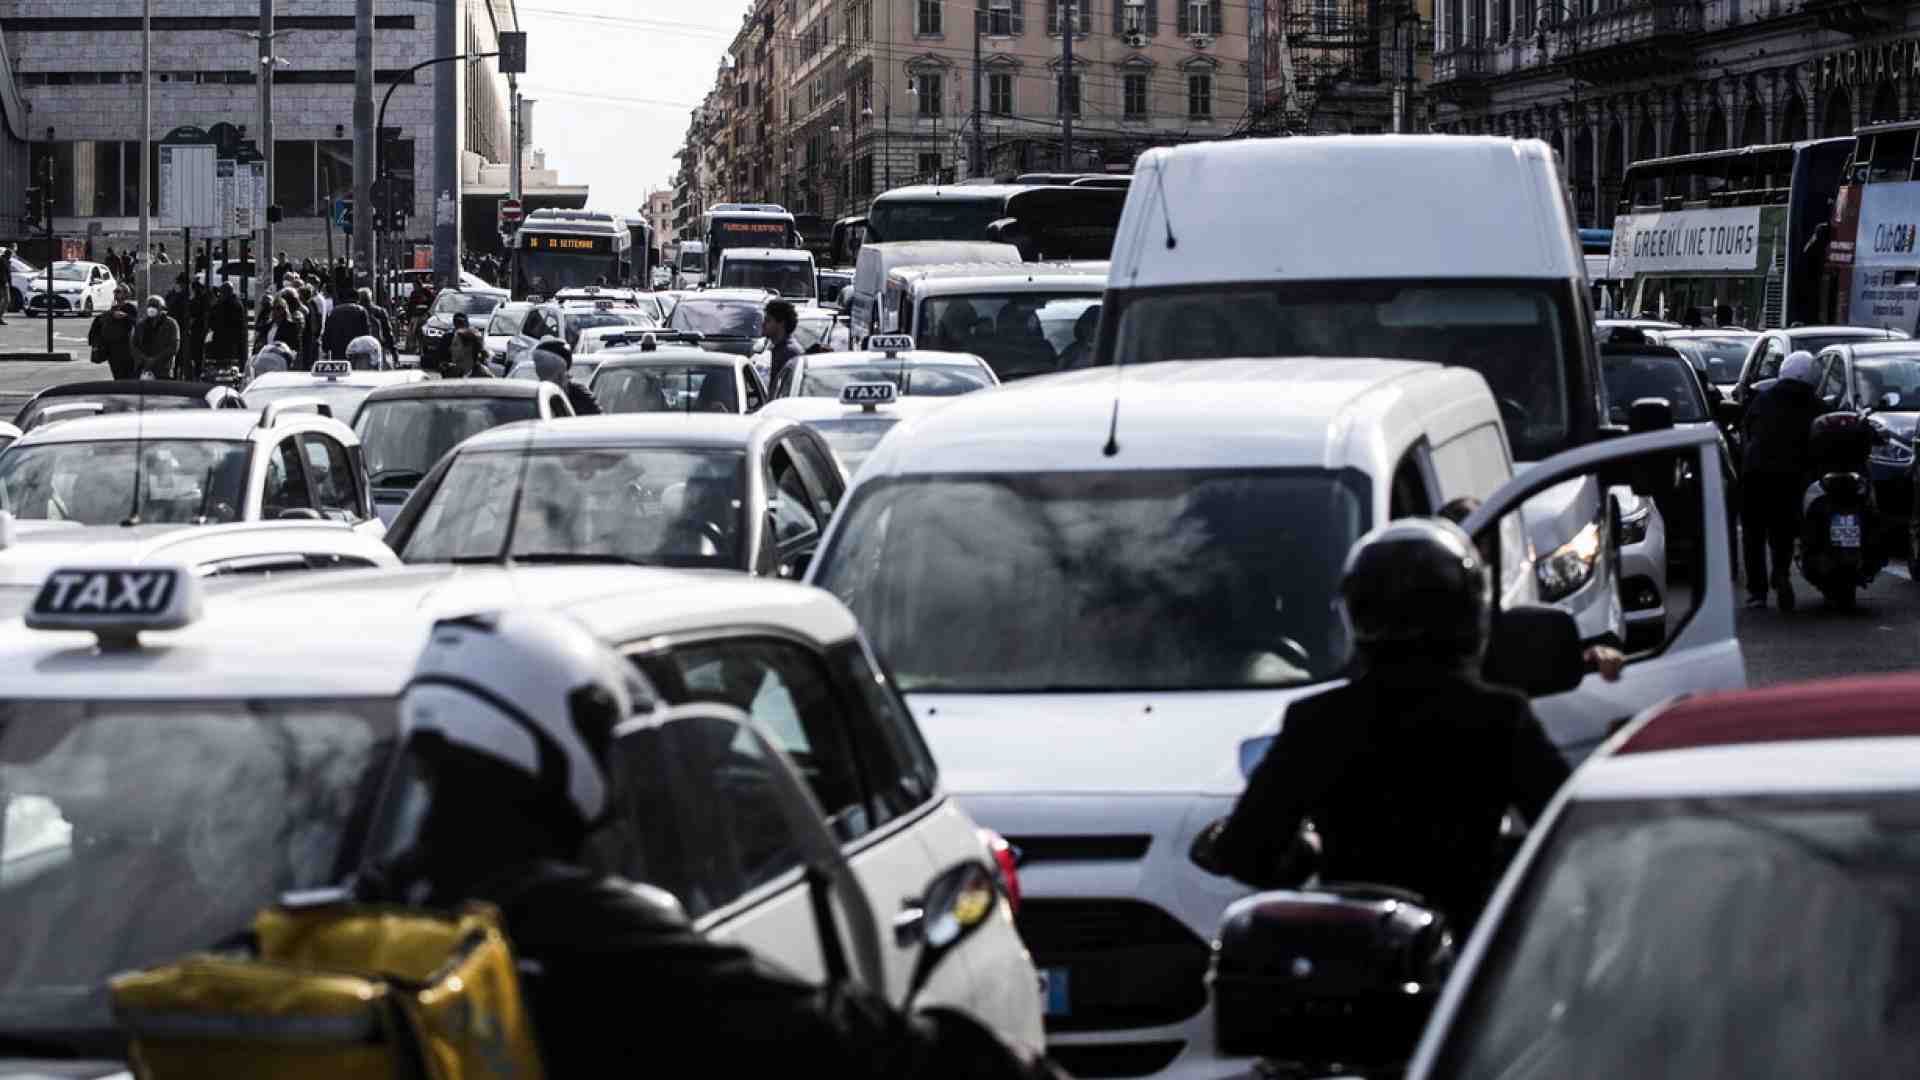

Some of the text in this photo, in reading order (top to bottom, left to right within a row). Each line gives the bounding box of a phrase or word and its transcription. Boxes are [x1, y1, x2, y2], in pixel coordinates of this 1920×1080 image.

[1633, 227, 1706, 257] GREENLINE
[1708, 224, 1754, 255] TOURS
[875, 337, 909, 346] TAXI
[318, 363, 346, 371] TAXI
[848, 386, 888, 398] TAXI
[51, 574, 168, 609] TAXI
